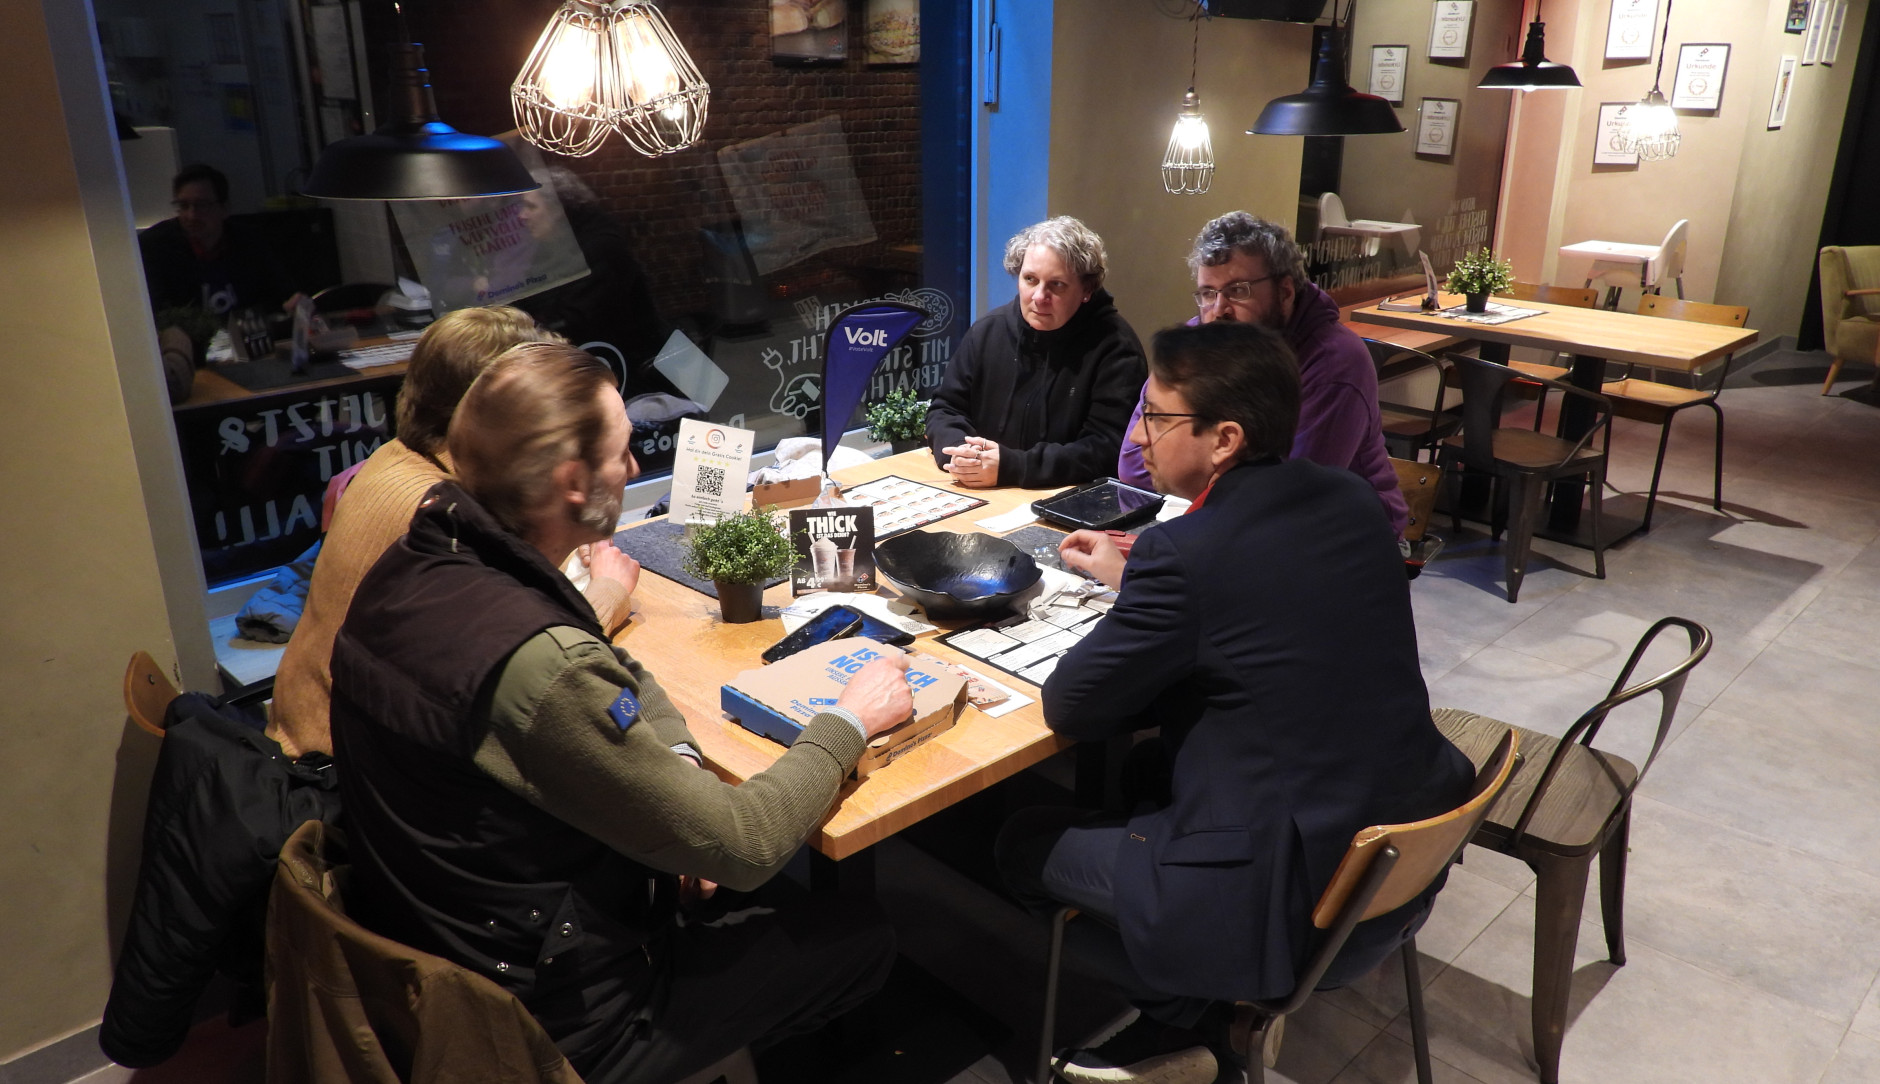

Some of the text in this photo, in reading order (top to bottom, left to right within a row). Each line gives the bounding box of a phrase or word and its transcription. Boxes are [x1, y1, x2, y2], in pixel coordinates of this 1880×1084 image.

[526, 273, 548, 286] Pizza
[844, 326, 888, 347] Volt
[806, 515, 859, 534] THICK
[893, 740, 917, 757] Domino's
